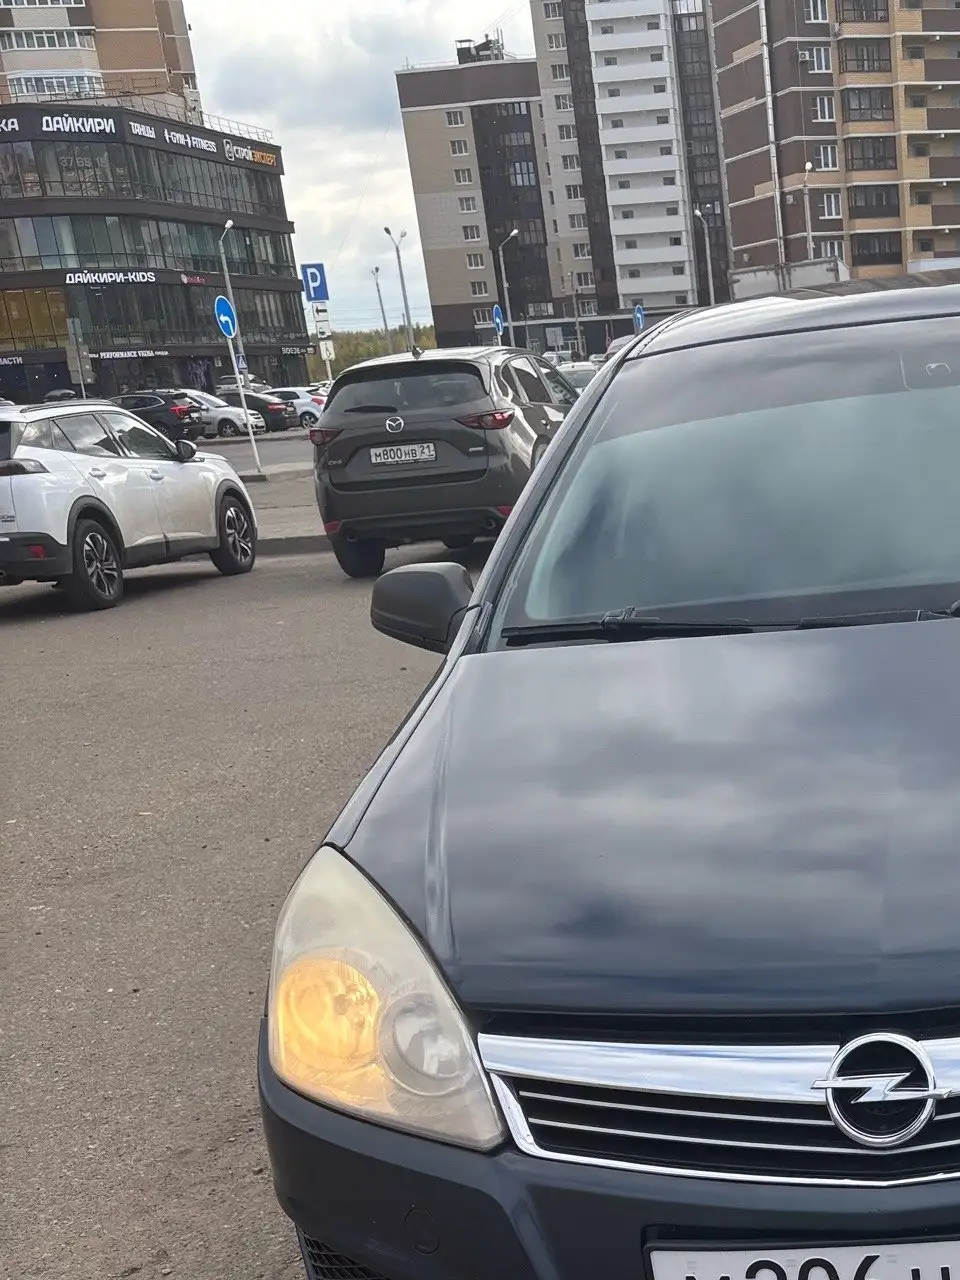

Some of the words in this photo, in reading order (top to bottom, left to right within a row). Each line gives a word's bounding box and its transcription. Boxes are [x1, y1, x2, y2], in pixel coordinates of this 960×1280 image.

[42, 113, 116, 133] ДАЙКИРИ
[191, 136, 217, 153] FITNESS
[65, 270, 156, 284] ДАЙКИРИ-KIDS
[306, 267, 321, 298] P
[374, 447, 418, 462] М800НВ
[419, 444, 432, 456] 21
